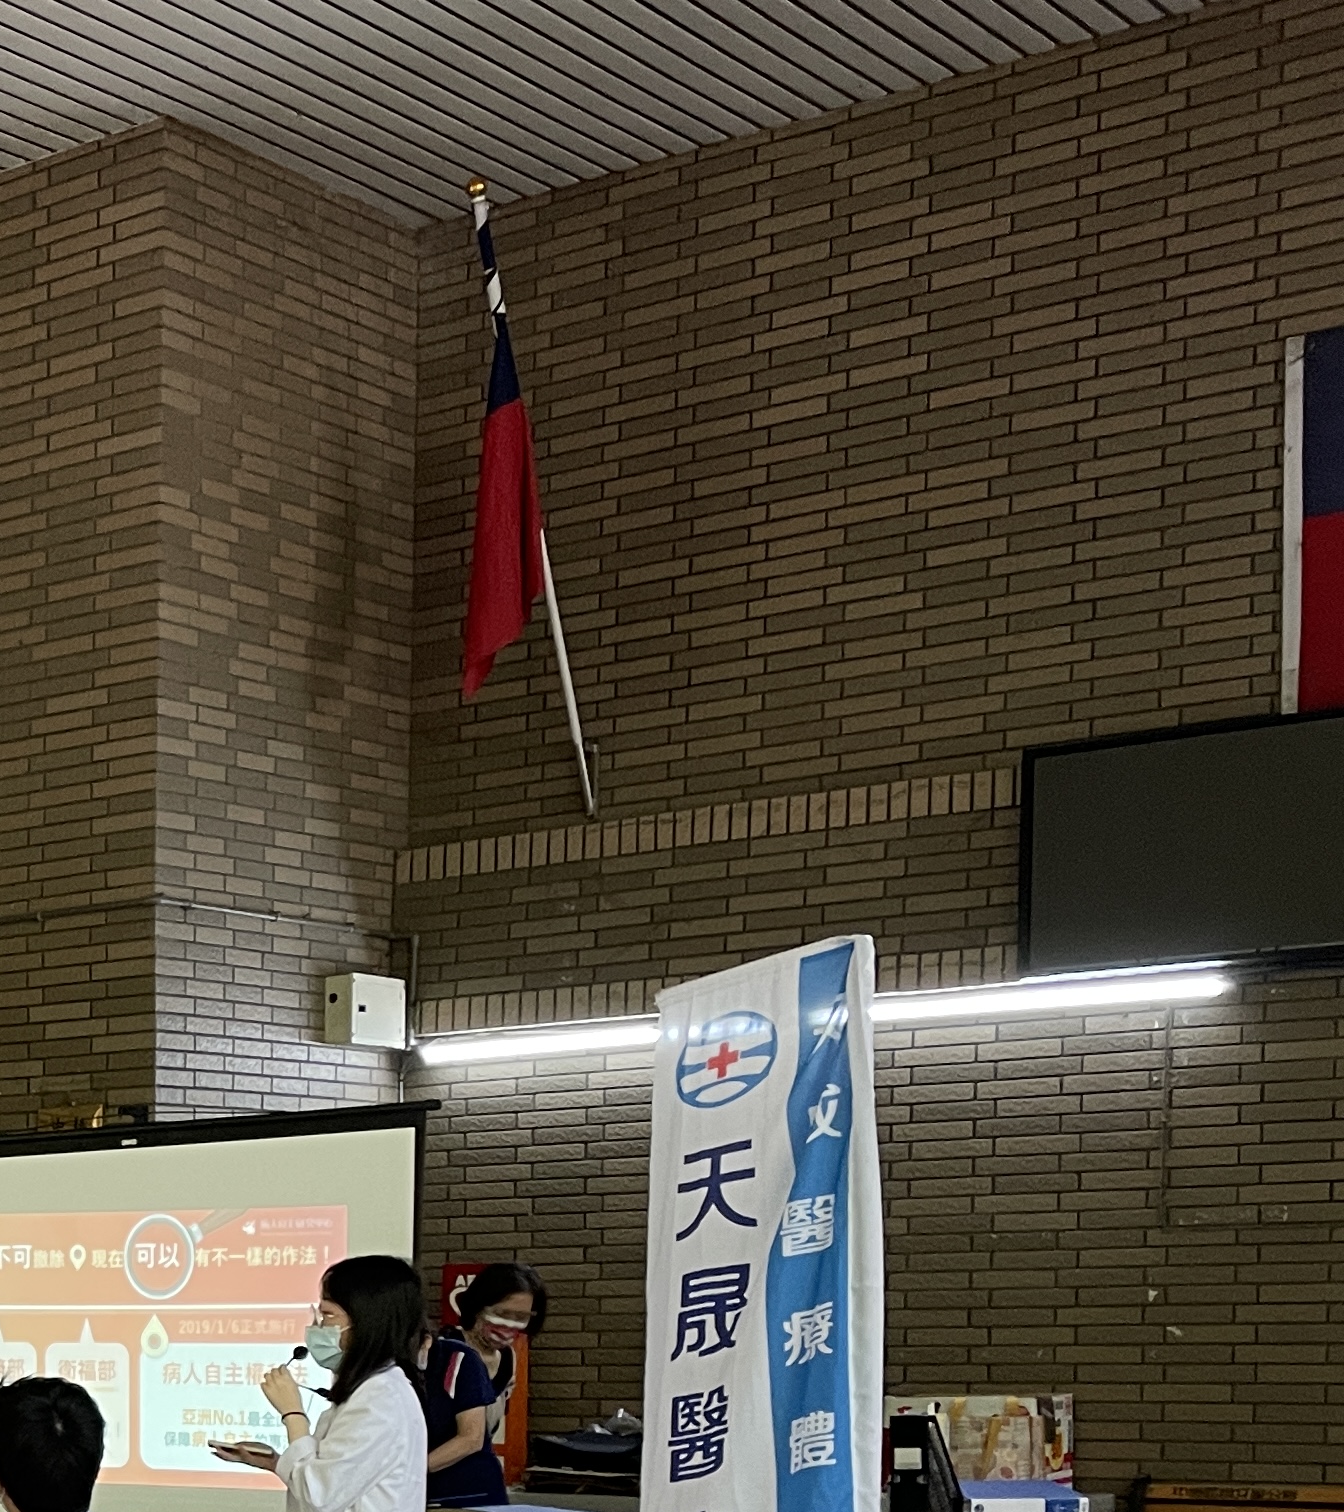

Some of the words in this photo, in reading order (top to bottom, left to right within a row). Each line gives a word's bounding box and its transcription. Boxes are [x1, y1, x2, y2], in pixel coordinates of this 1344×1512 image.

[163, 1361, 308, 1386] 病人自主權法
